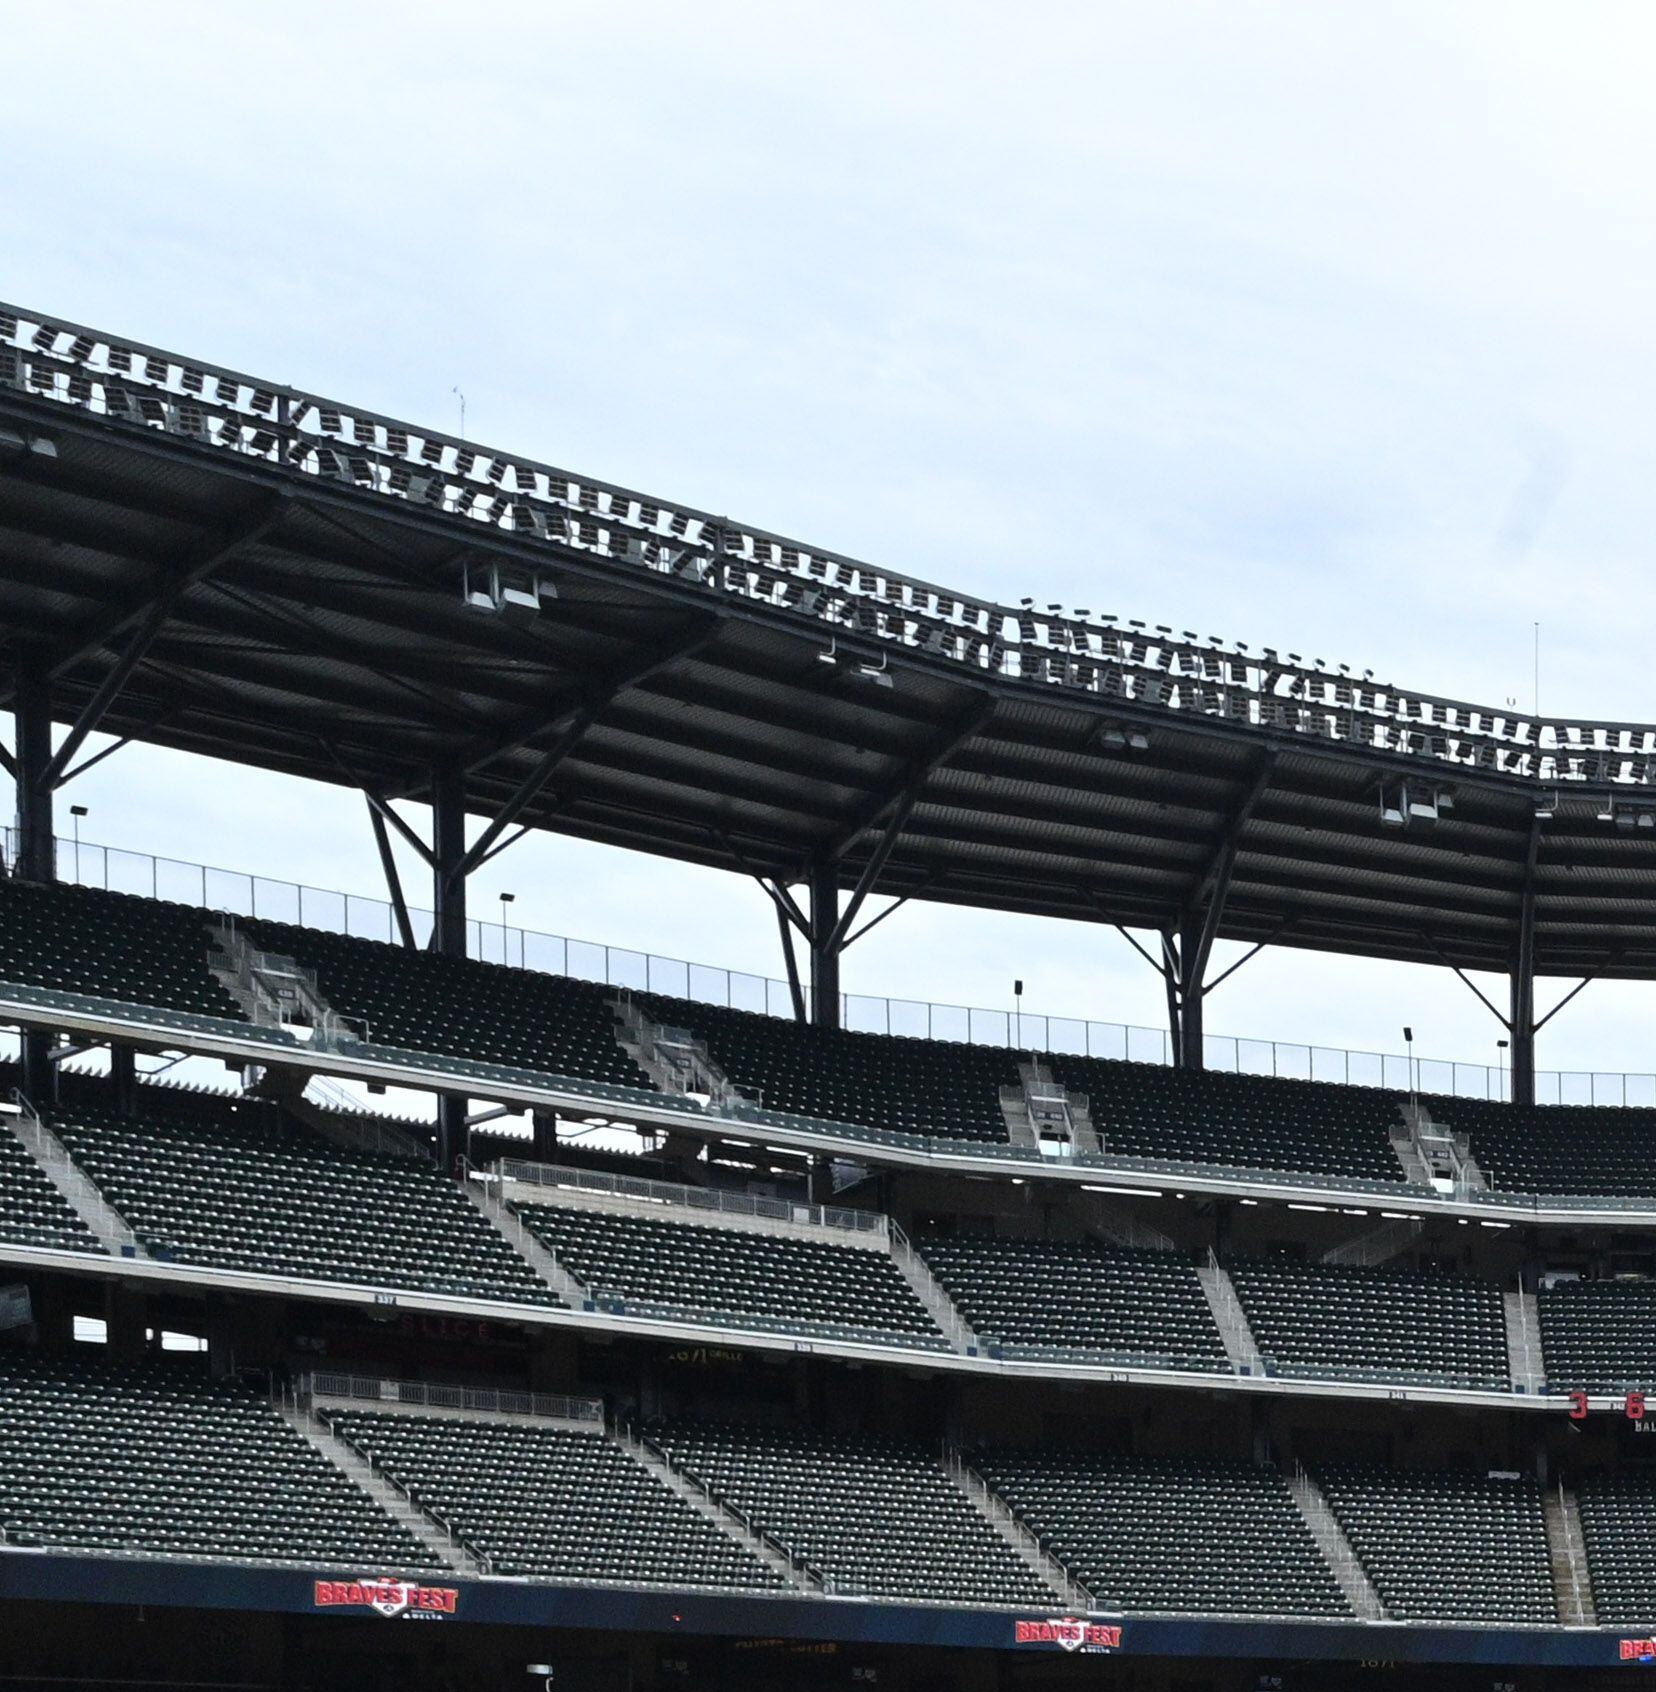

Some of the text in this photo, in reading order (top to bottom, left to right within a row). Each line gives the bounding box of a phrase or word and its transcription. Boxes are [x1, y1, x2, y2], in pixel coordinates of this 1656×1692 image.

[1569, 1392, 1588, 1419] 3
[1625, 1392, 1645, 1419] 6
[315, 1580, 459, 1613] BRAVES FEST
[1016, 1621, 1122, 1647] BRAVES FEST
